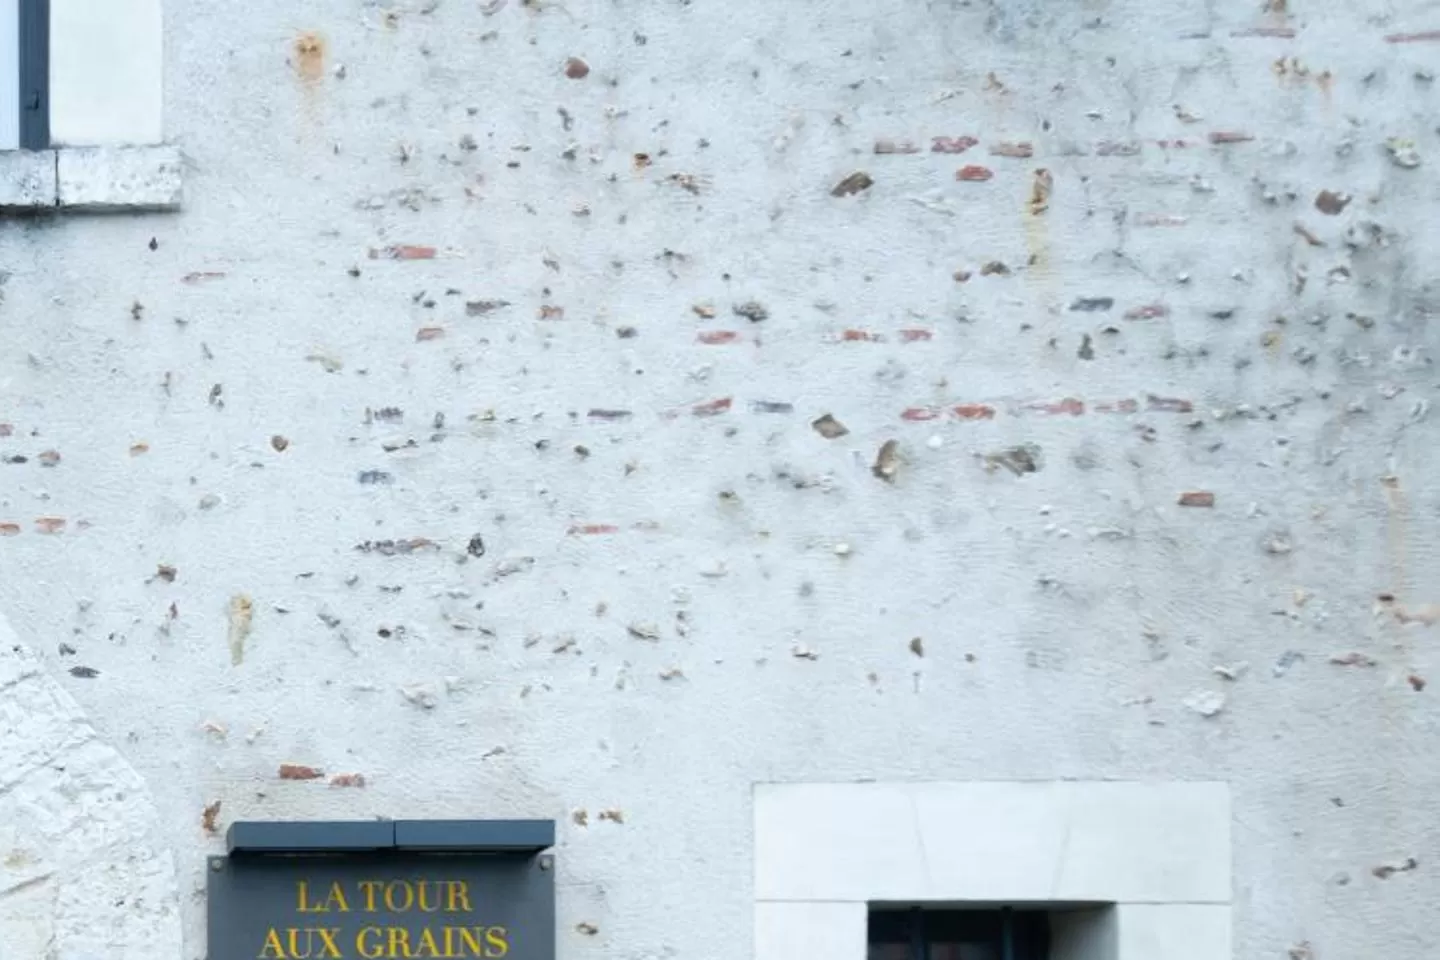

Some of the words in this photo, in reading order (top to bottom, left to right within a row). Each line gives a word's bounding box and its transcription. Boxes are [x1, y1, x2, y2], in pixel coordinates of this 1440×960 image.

[296, 880, 349, 913] LA
[358, 880, 473, 913] TOUR
[259, 927, 343, 959] AUX
[355, 926, 510, 959] GRAINS
